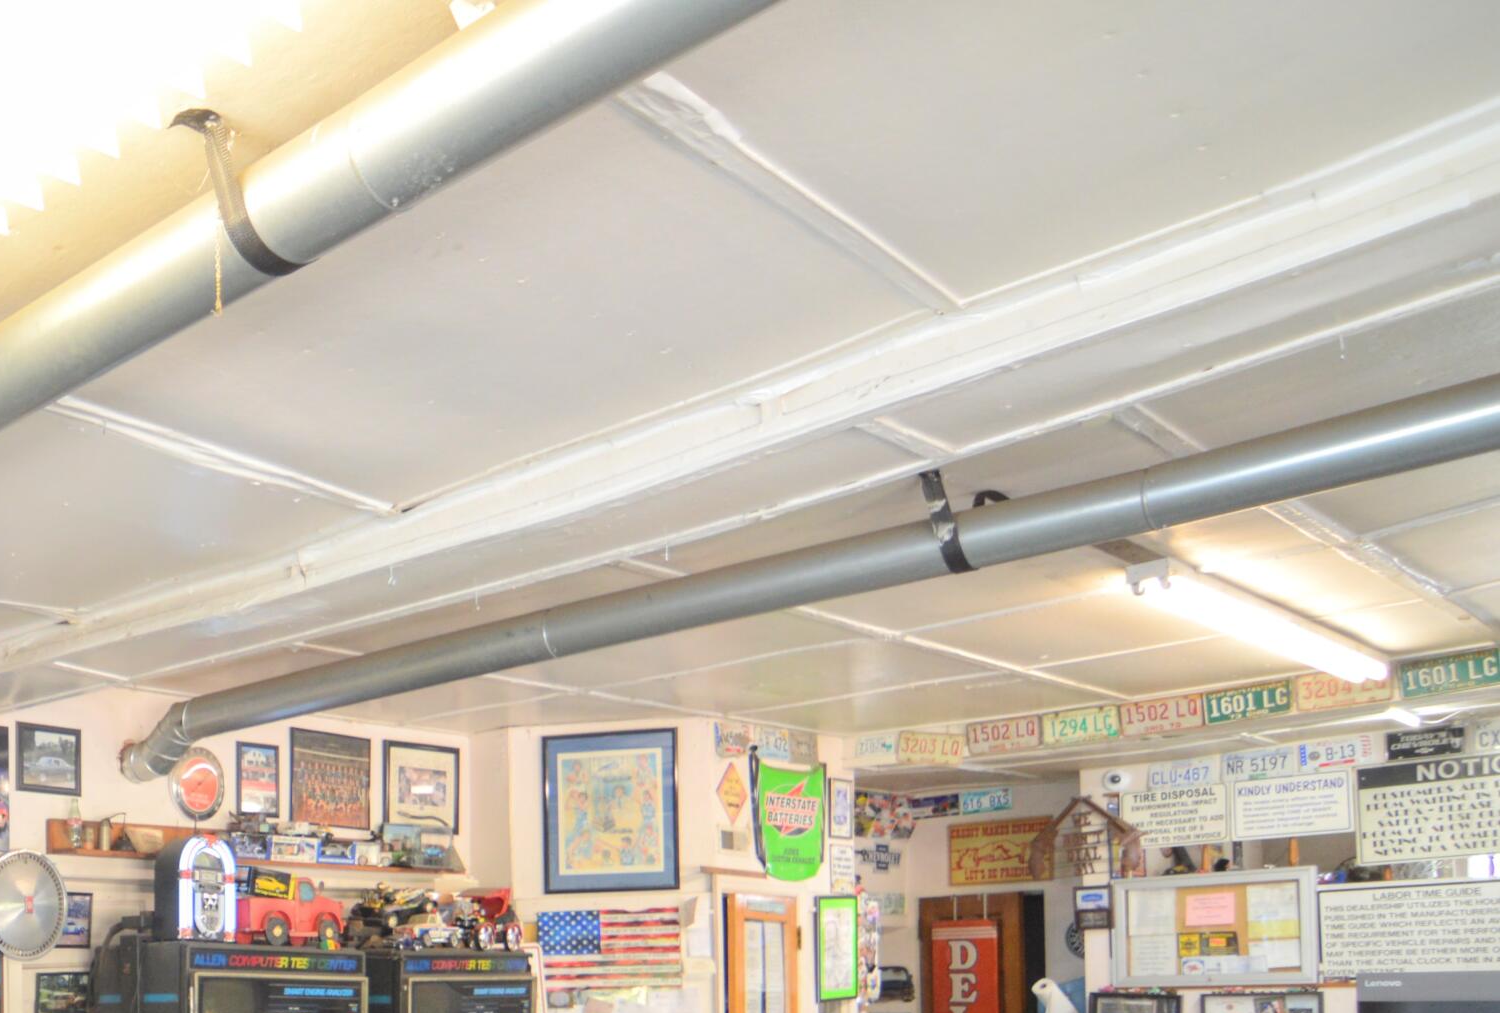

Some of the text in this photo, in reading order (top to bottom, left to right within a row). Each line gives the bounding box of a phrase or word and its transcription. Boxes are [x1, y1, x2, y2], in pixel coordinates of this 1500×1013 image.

[1406, 664, 1458, 690] 1601
[1302, 679, 1353, 700] 3204
[1209, 693, 1257, 717] 1601
[1125, 703, 1170, 725] 1502
[971, 724, 1010, 744] 1502
[1049, 718, 1089, 738] 1294
[900, 735, 937, 754] 3203
[1249, 754, 1288, 774] 5197
[1416, 755, 1500, 782] NOTIC
[1237, 777, 1344, 797] KINDLY UNDERSTAND
[1132, 787, 1216, 804] TIRE DISPOSAL
[765, 796, 818, 812] INTERSTATE
[766, 811, 814, 827] BATTERIES
[1372, 886, 1482, 902] LABOR TIME GUIDE
[1346, 902, 1405, 912] DEALERSHIP
[1454, 899, 1474, 907] THE
[1389, 911, 1409, 919] THE
[1347, 921, 1377, 930] GUIDE
[1414, 917, 1468, 928] REFLECTS
[1470, 917, 1486, 926] AN
[1347, 929, 1415, 939] REQUIREMENT
[1417, 928, 1440, 937] FOR
[1441, 927, 1462, 936] THE
[1339, 939, 1384, 949] SPECIFIC
[1384, 937, 1426, 947] VEHICLE
[1428, 936, 1471, 946] REPAIRS
[1473, 936, 1497, 945] AND
[1347, 948, 1404, 958] THEREFORE
[1421, 946, 1458, 956] EITHER
[194, 953, 358, 971] ALLEN COMPUTER TEST CENTER
[431, 959, 477, 971] COMPUTER
[1354, 957, 1375, 966] THE
[1376, 956, 1416, 966] ACTUAL
[1416, 955, 1453, 965] CLOCK
[1456, 955, 1480, 964] TIME
[1364, 979, 1403, 988] Lenovo
